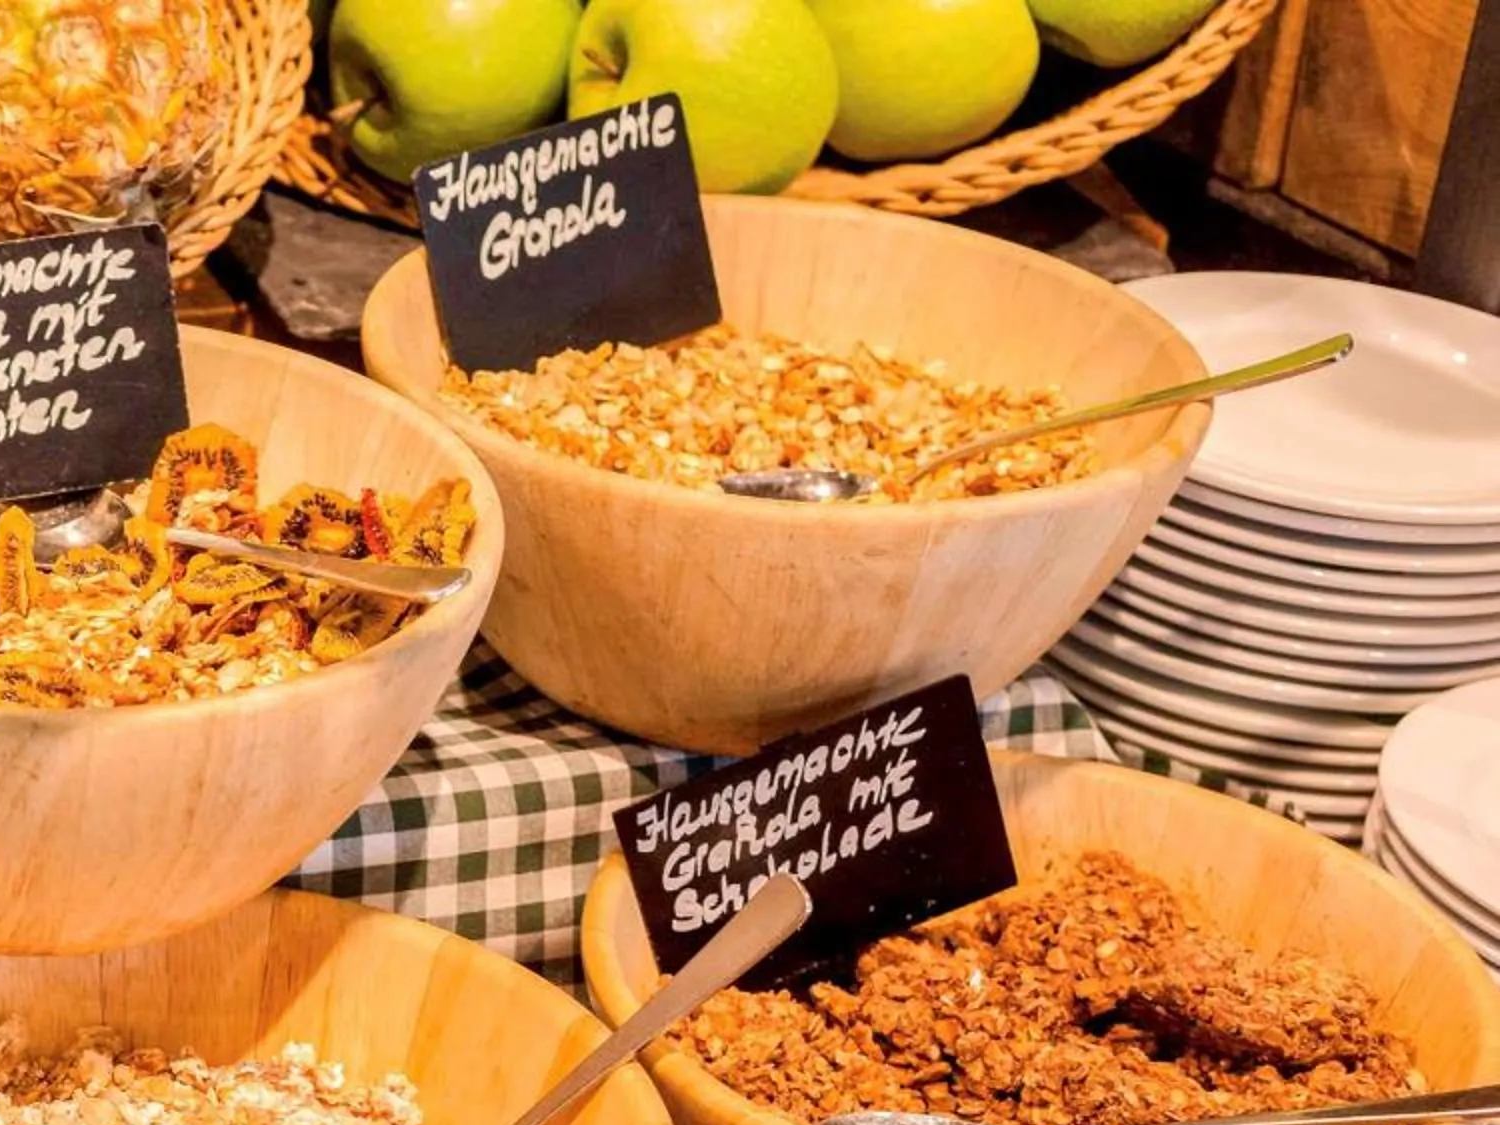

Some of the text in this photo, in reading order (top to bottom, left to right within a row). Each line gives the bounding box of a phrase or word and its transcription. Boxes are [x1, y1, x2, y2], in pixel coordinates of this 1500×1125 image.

[429, 98, 677, 222] Hausgemachte
[479, 173, 627, 280] Granola
[27, 278, 116, 343] mit
[635, 706, 927, 853] Hausgemachte
[661, 747, 918, 892] Granola mit
